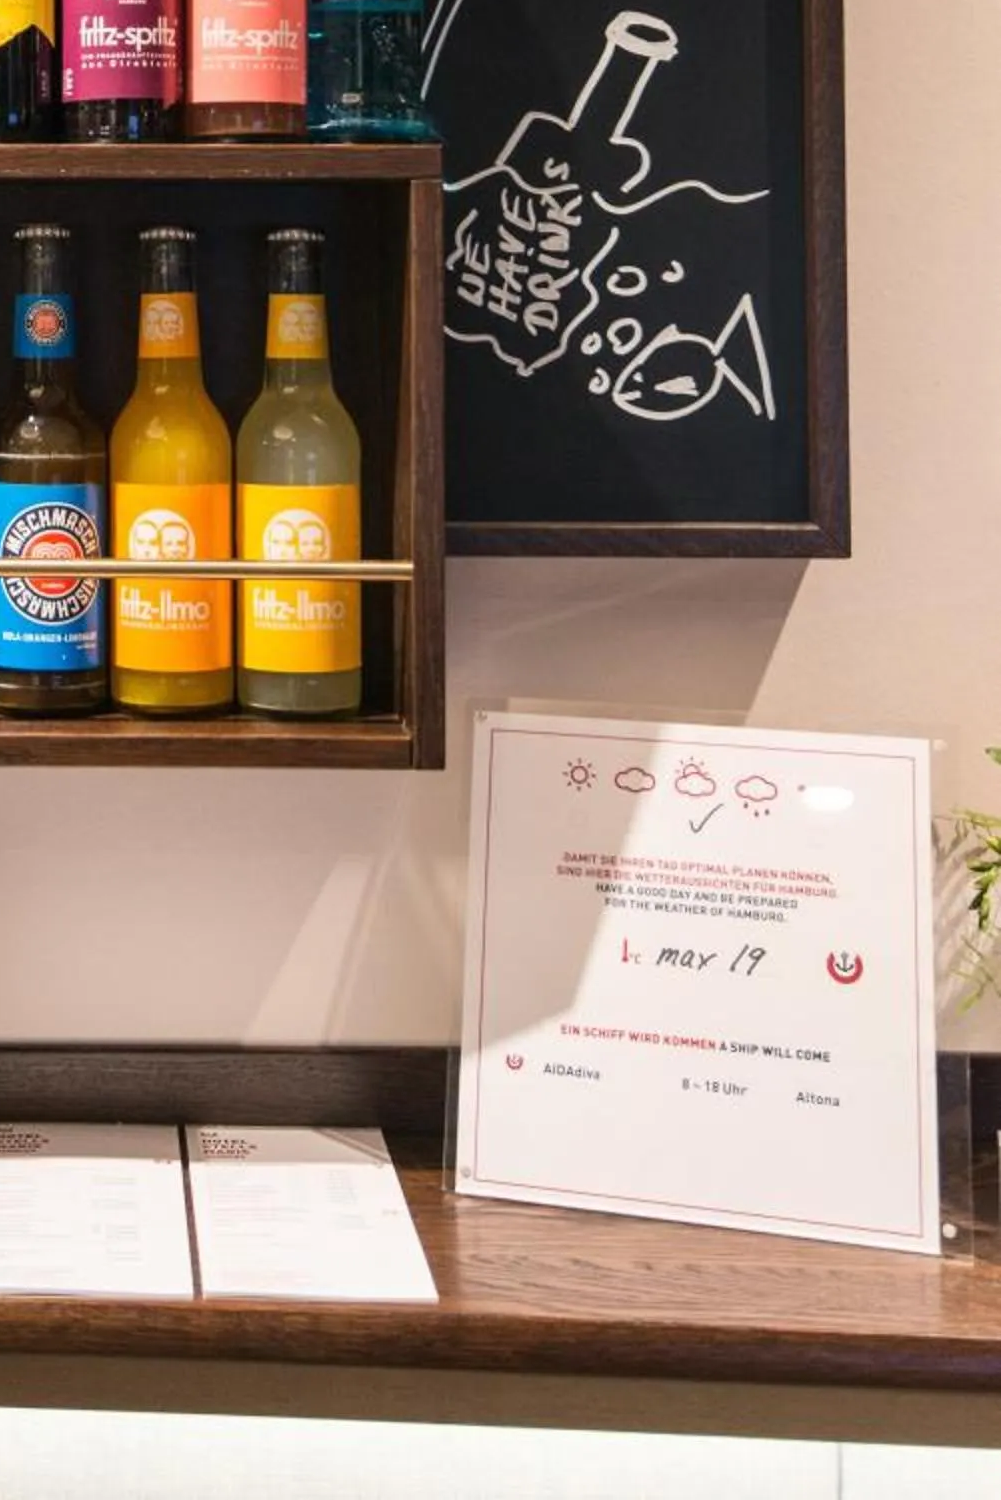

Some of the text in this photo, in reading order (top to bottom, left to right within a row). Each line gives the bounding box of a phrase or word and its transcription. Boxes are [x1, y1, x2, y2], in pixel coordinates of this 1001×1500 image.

[79, 16, 176, 52] fritz-spritz
[201, 18, 298, 57] fritz-spritz
[457, 234, 491, 307] WE
[488, 188, 537, 323] HAVE
[120, 586, 211, 621] fritz-limo
[252, 587, 346, 621] fritz-limo
[563, 852, 597, 866] DAMIT
[681, 860, 729, 875] OPTIMAL
[732, 863, 778, 879] PLANEN
[596, 882, 626, 895] HAVE
[669, 888, 691, 901] DAY
[694, 890, 719, 903] AND
[737, 894, 798, 910] PREPARED
[629, 900, 651, 912] THE
[654, 902, 709, 917] WEATHER
[729, 943, 768, 977] 19
[560, 1023, 832, 1064] EIN SCHIFF WIRD KOMMEN A SHIP WILL COME
[705, 1080, 720, 1093] 18
[722, 1082, 749, 1097] Uhr
[796, 1092, 841, 1108] Altona
